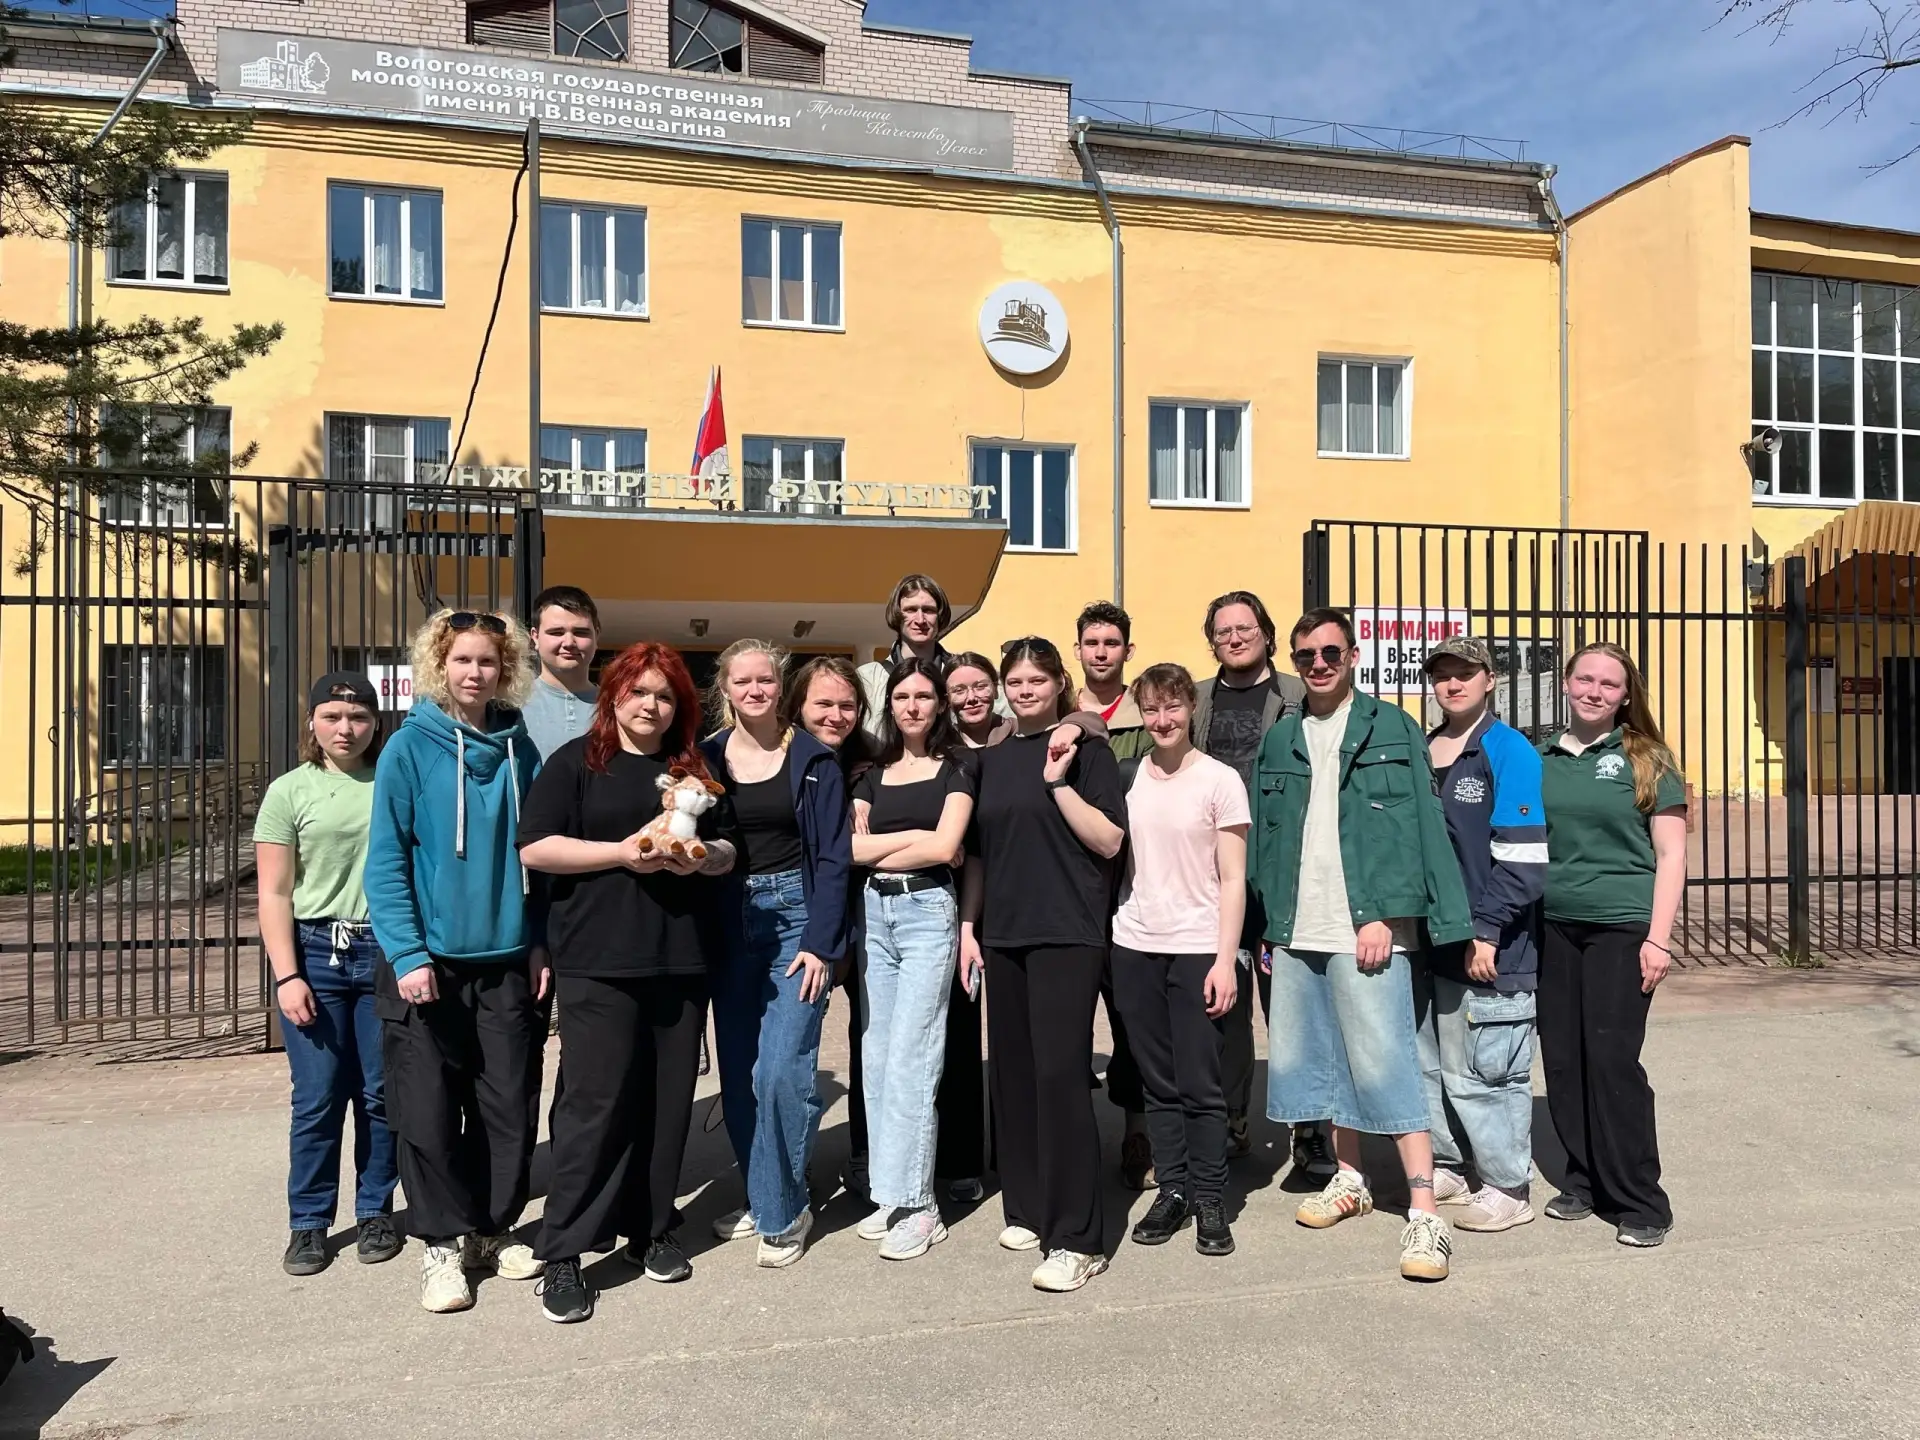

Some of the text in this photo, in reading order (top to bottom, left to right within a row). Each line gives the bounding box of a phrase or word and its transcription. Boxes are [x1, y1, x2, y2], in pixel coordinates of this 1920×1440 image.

[376, 50, 764, 109] Вологодская государственная
[351, 68, 791, 128] молочнохозяйственная академия
[806, 99, 893, 121] Традиции
[425, 93, 727, 139] имени Н.В.Верещагина
[865, 121, 944, 141] Качество
[936, 138, 988, 156] Успех
[768, 478, 996, 510] ФАКУЛЬТЕТ
